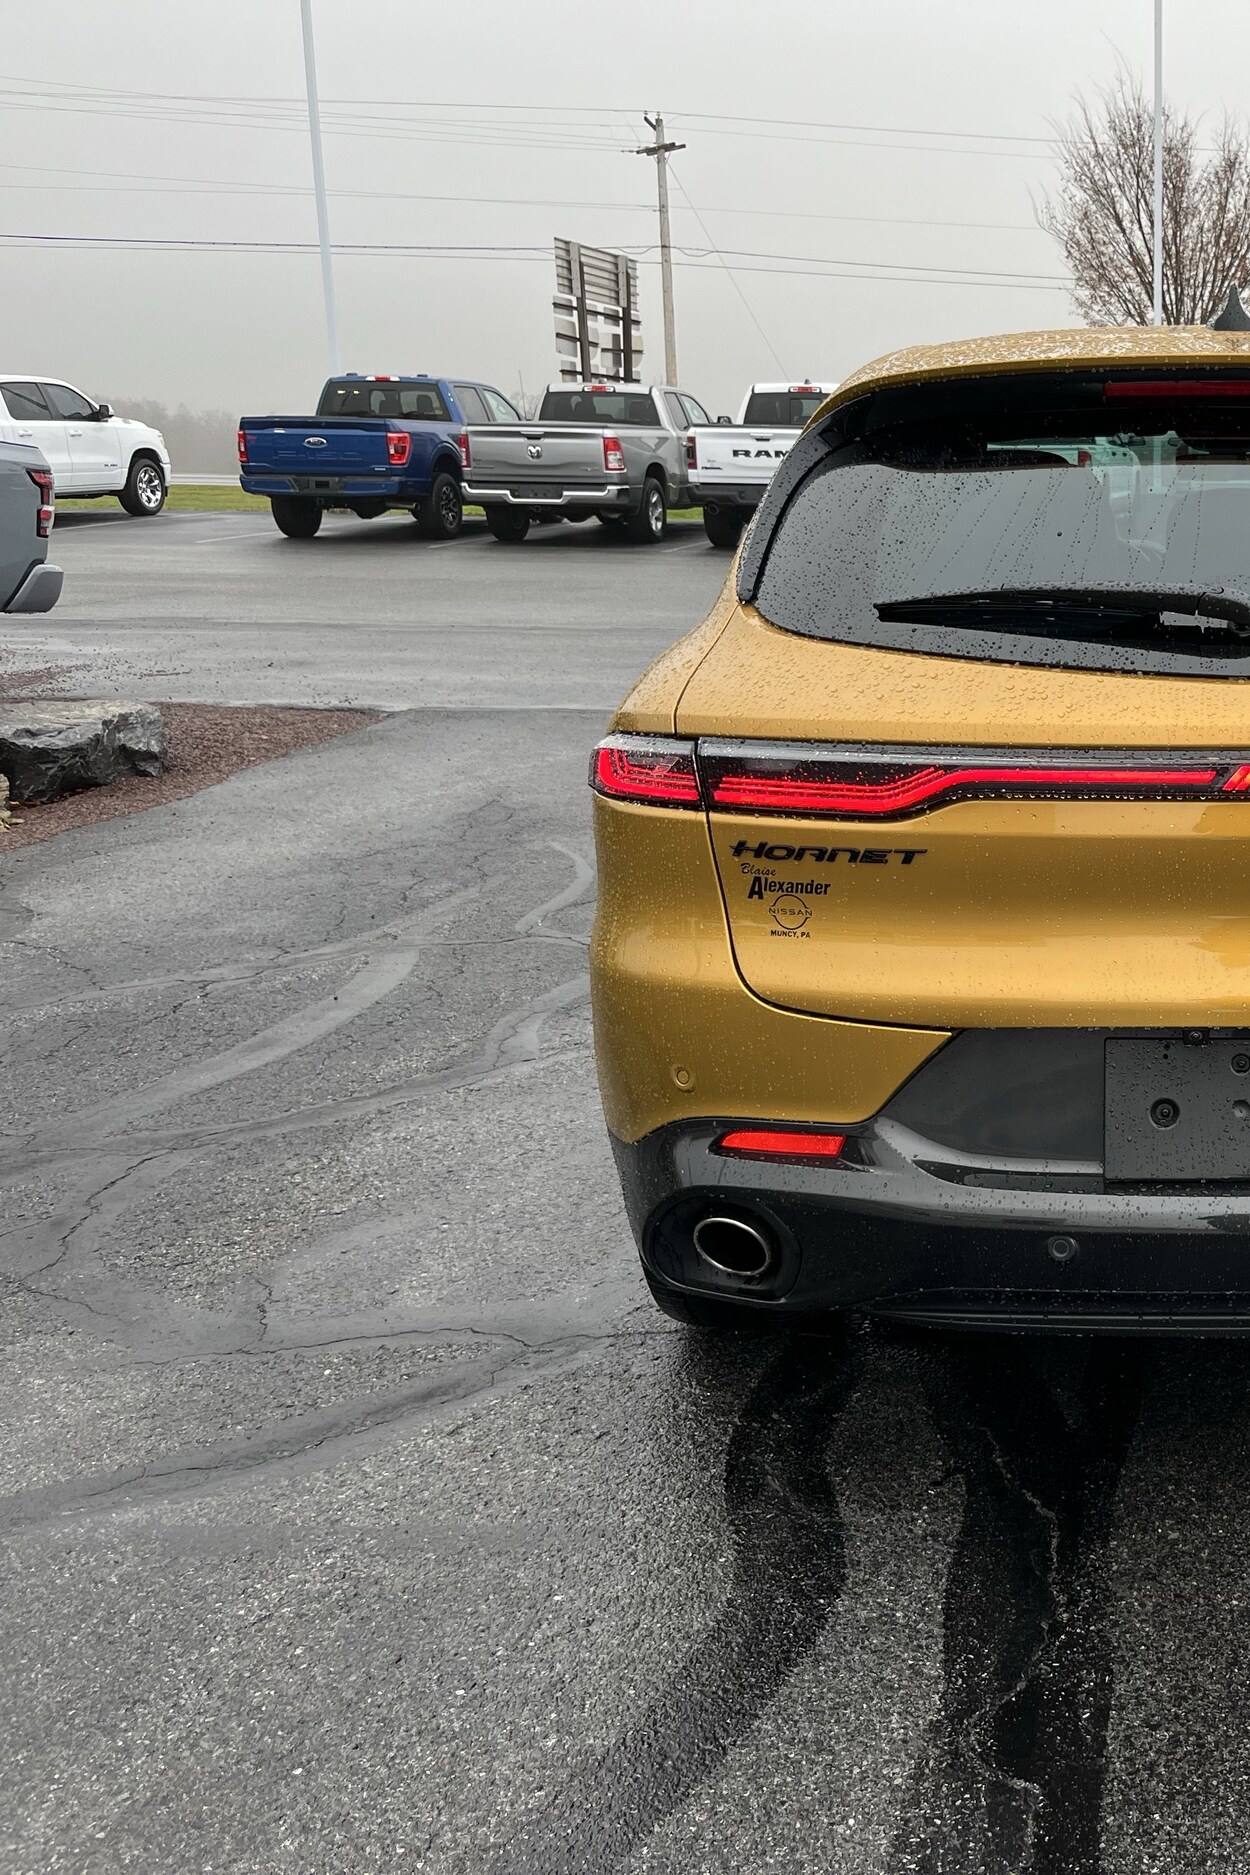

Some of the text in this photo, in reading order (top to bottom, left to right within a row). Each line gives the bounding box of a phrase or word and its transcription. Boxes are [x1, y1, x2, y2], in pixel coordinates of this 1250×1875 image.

[729, 839, 928, 865] HORNET
[740, 862, 777, 877] Blaise
[747, 876, 832, 900] Alexander
[768, 907, 813, 917] NISSAN
[770, 929, 812, 939] MUNCY, PA
